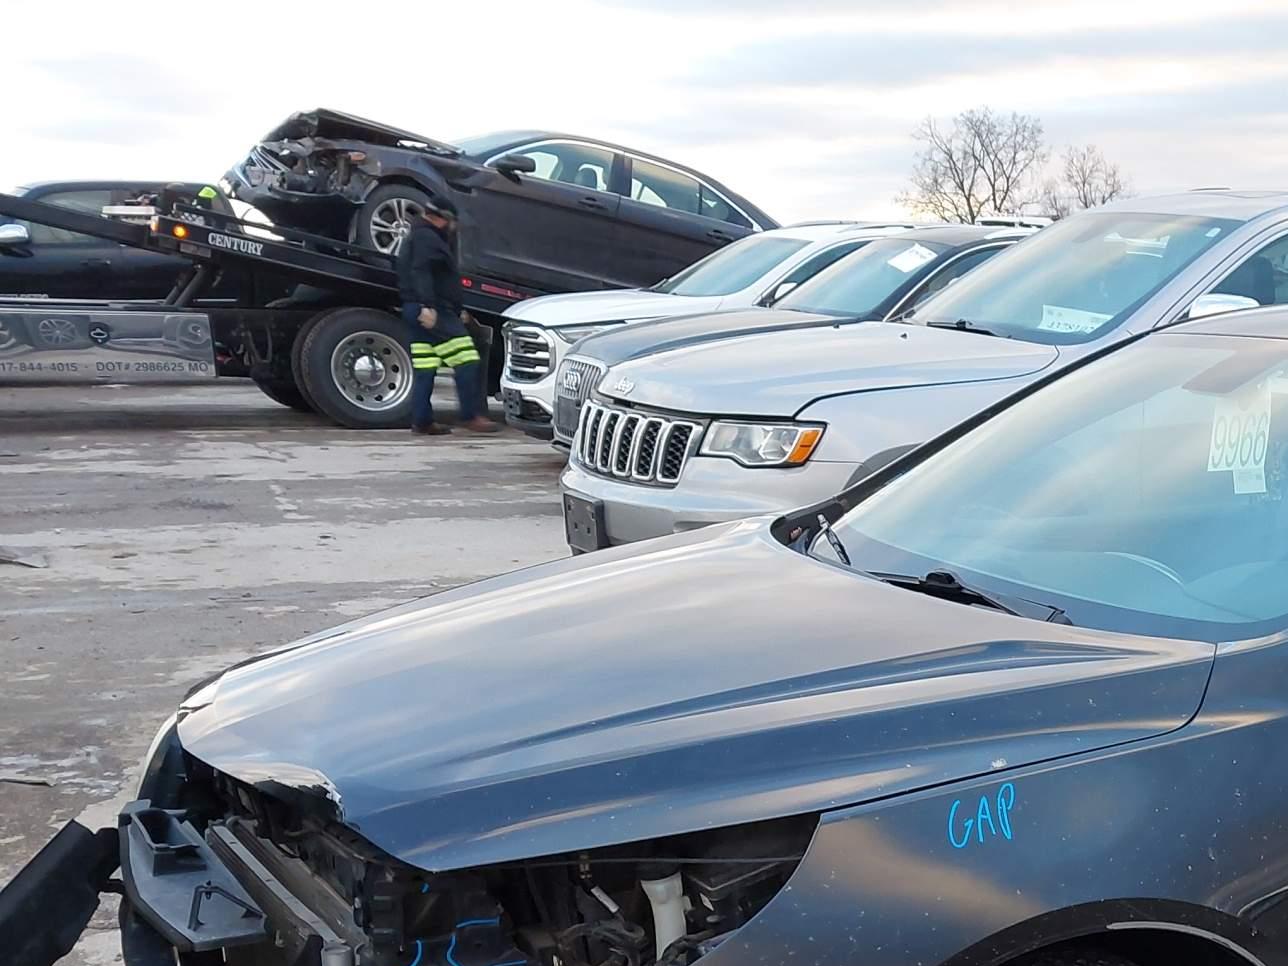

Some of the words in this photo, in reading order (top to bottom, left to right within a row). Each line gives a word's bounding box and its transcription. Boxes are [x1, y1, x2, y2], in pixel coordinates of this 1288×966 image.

[208, 232, 263, 256] CENTURY
[95, 361, 131, 373] DOT#
[1211, 411, 1268, 468] 9966
[947, 783, 1016, 848] GAP
